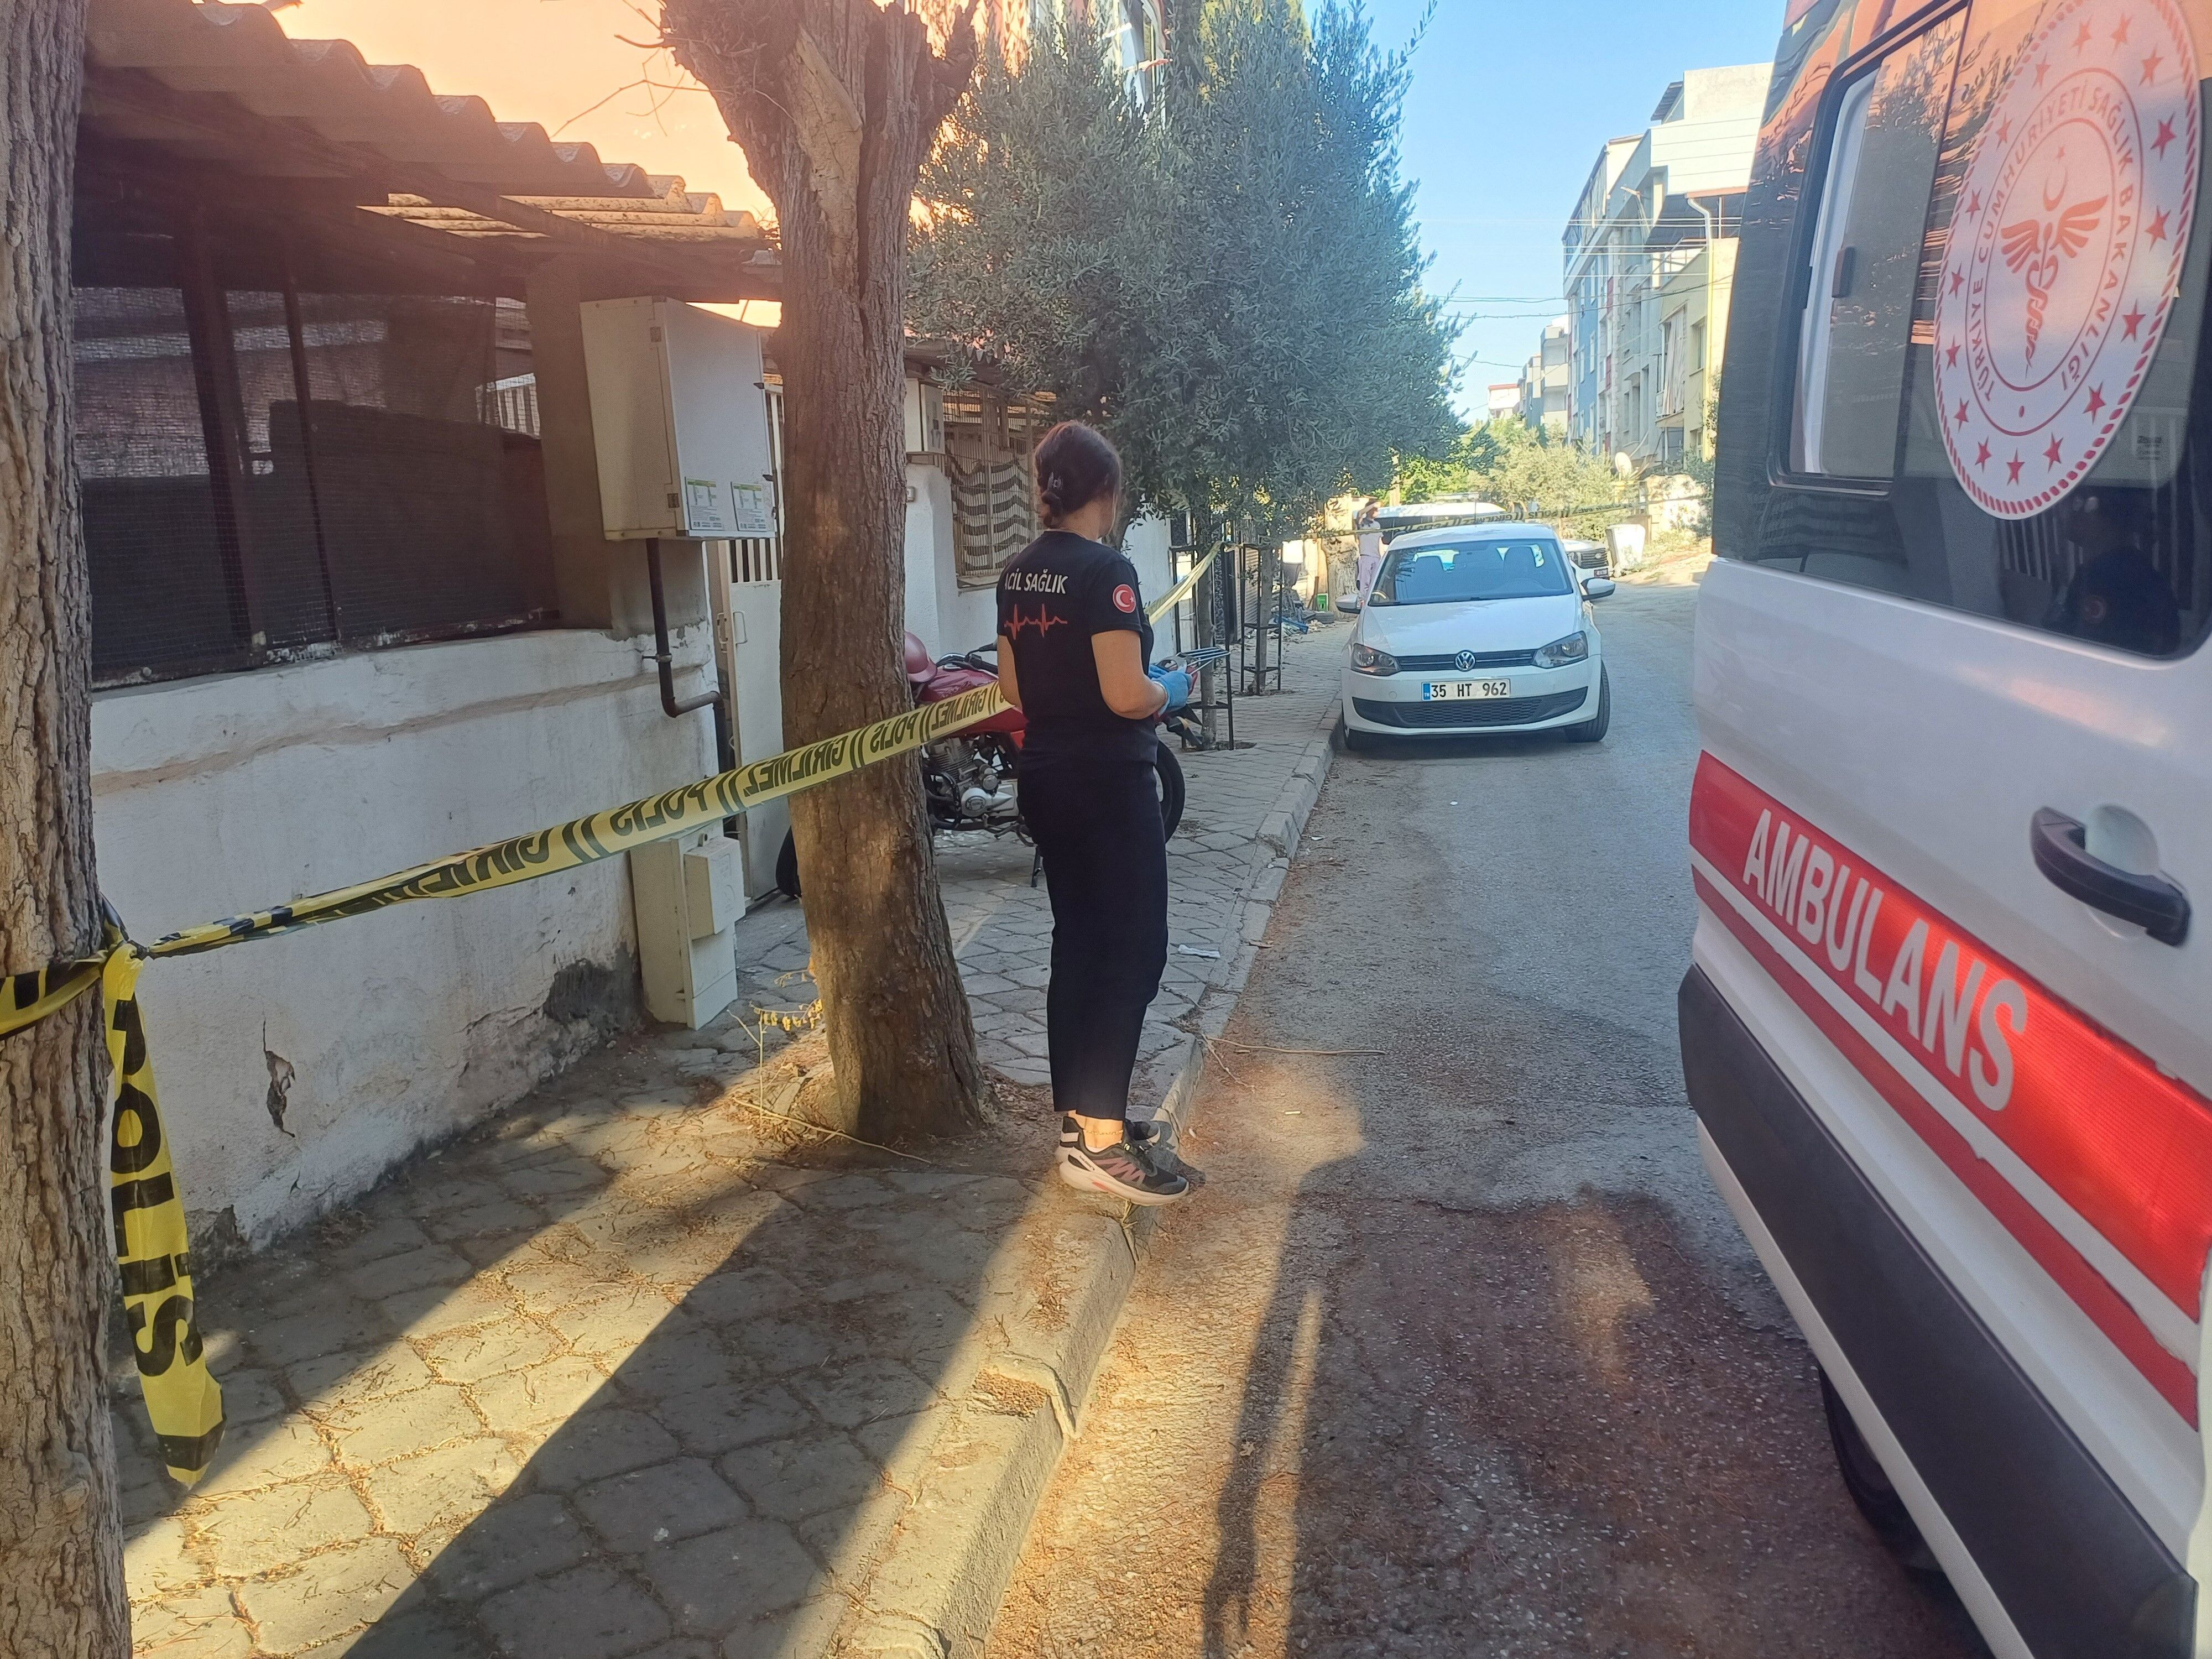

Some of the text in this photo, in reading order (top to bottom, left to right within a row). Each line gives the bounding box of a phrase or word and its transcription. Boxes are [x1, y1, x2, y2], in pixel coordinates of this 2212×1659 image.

[1969, 79, 2134, 401] TÜRKİYE CUMHURİYETİ SAĞLIK BAKANLIĞI
[1024, 568, 1068, 594] SAĞLIK
[1431, 685, 1446, 697] 35
[1457, 684, 1472, 697] HT
[1482, 682, 1507, 696] 962
[1742, 808, 2028, 1112] AMBULANS
